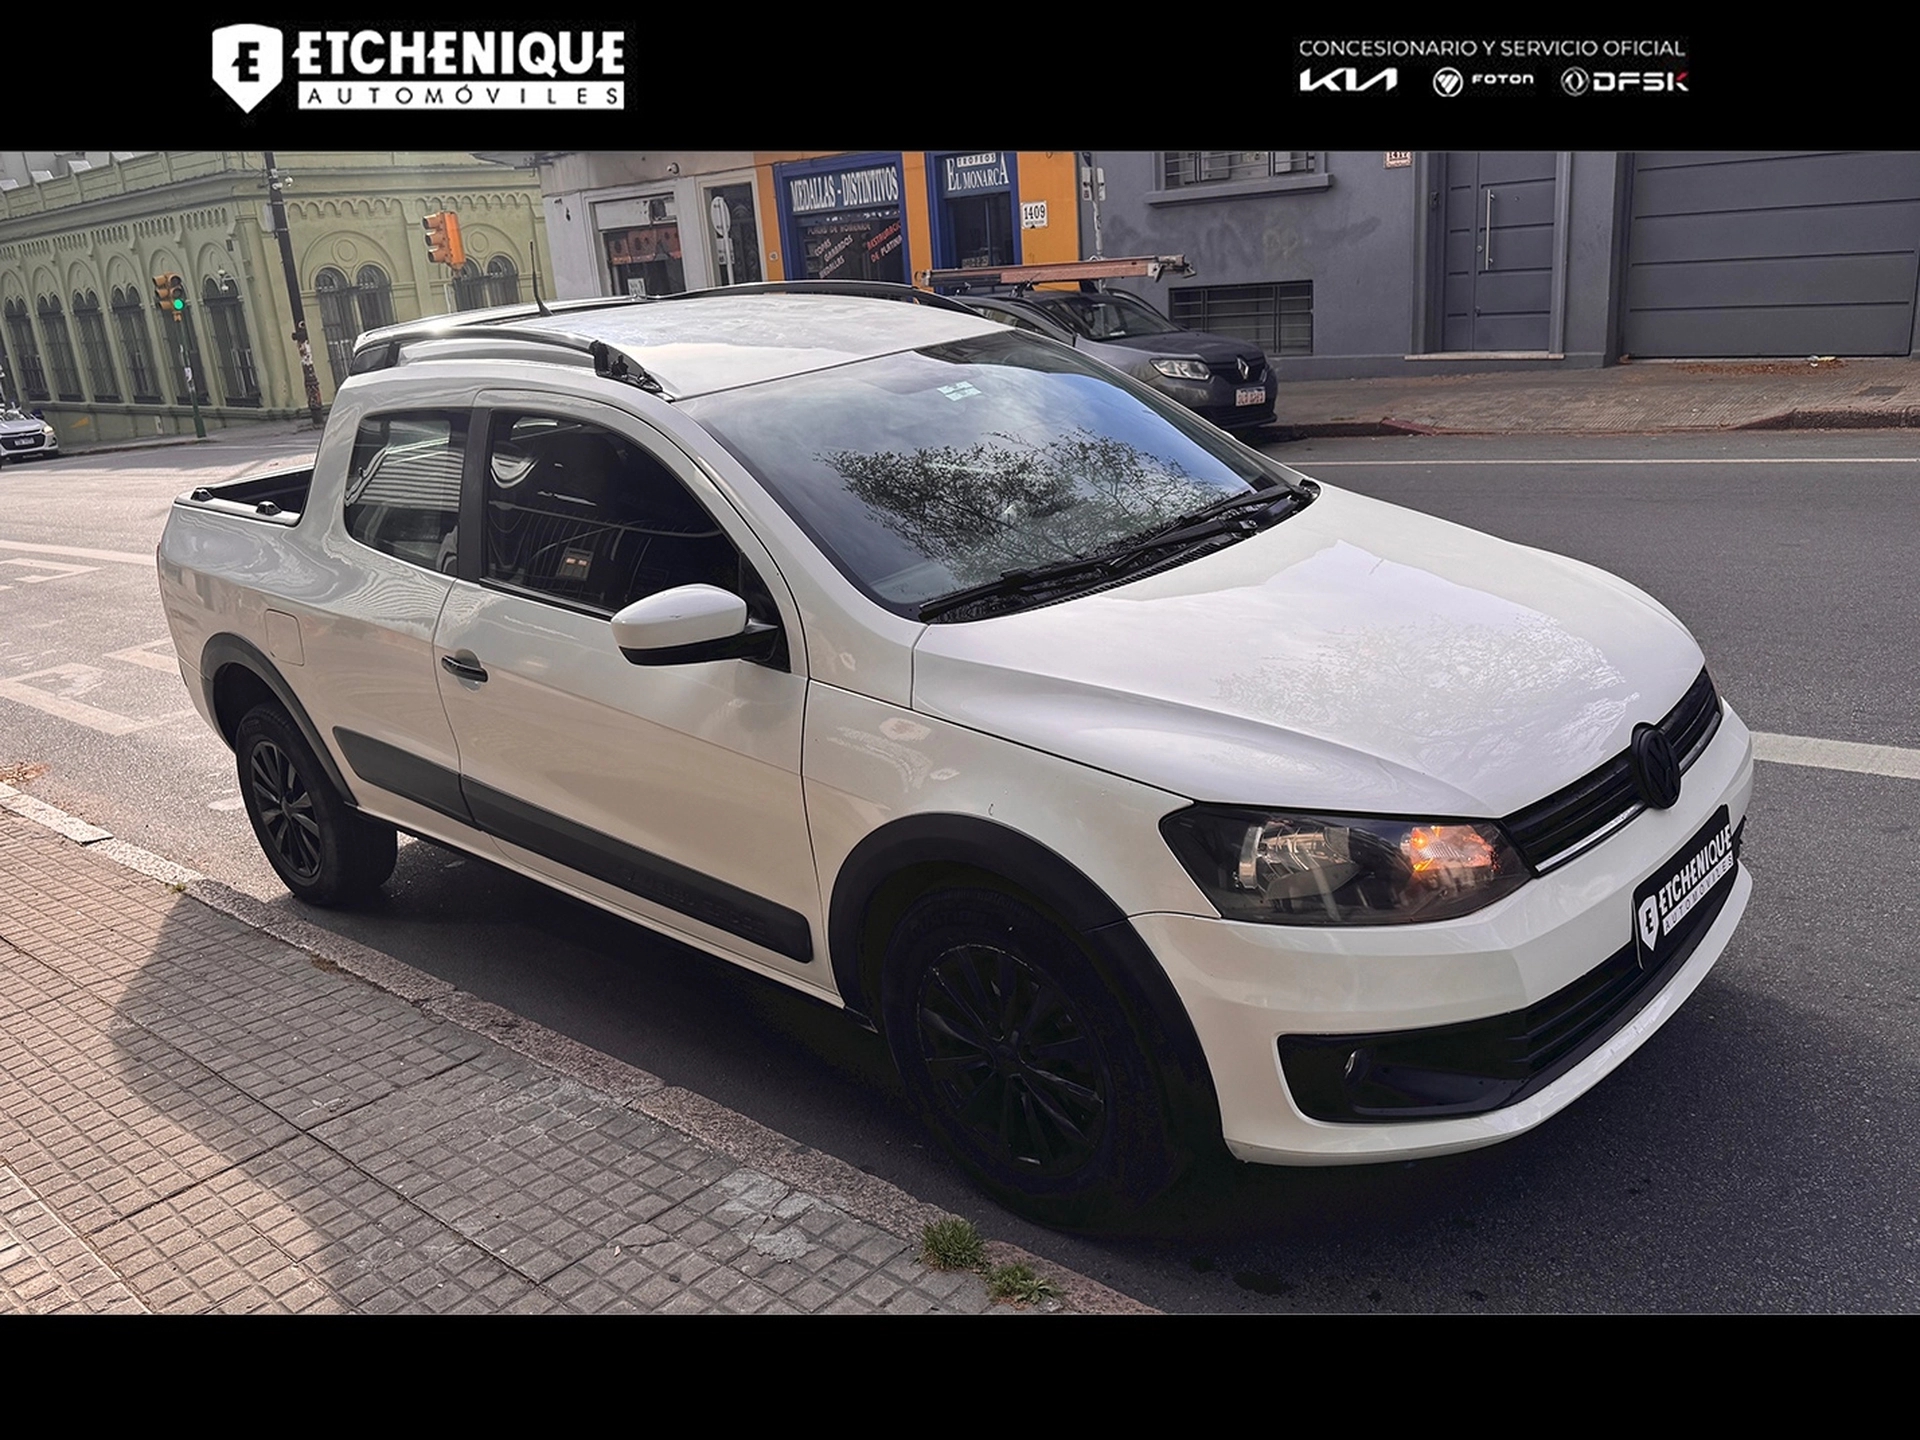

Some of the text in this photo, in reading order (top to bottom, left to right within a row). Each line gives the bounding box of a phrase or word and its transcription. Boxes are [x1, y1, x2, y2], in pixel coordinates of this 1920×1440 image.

[957, 153, 996, 166] TROFEOS
[790, 166, 900, 212] MEDALLAS DISTINTIVOS
[1024, 204, 1046, 220] 1409
[1658, 824, 1733, 917] ETCHENIQUE
